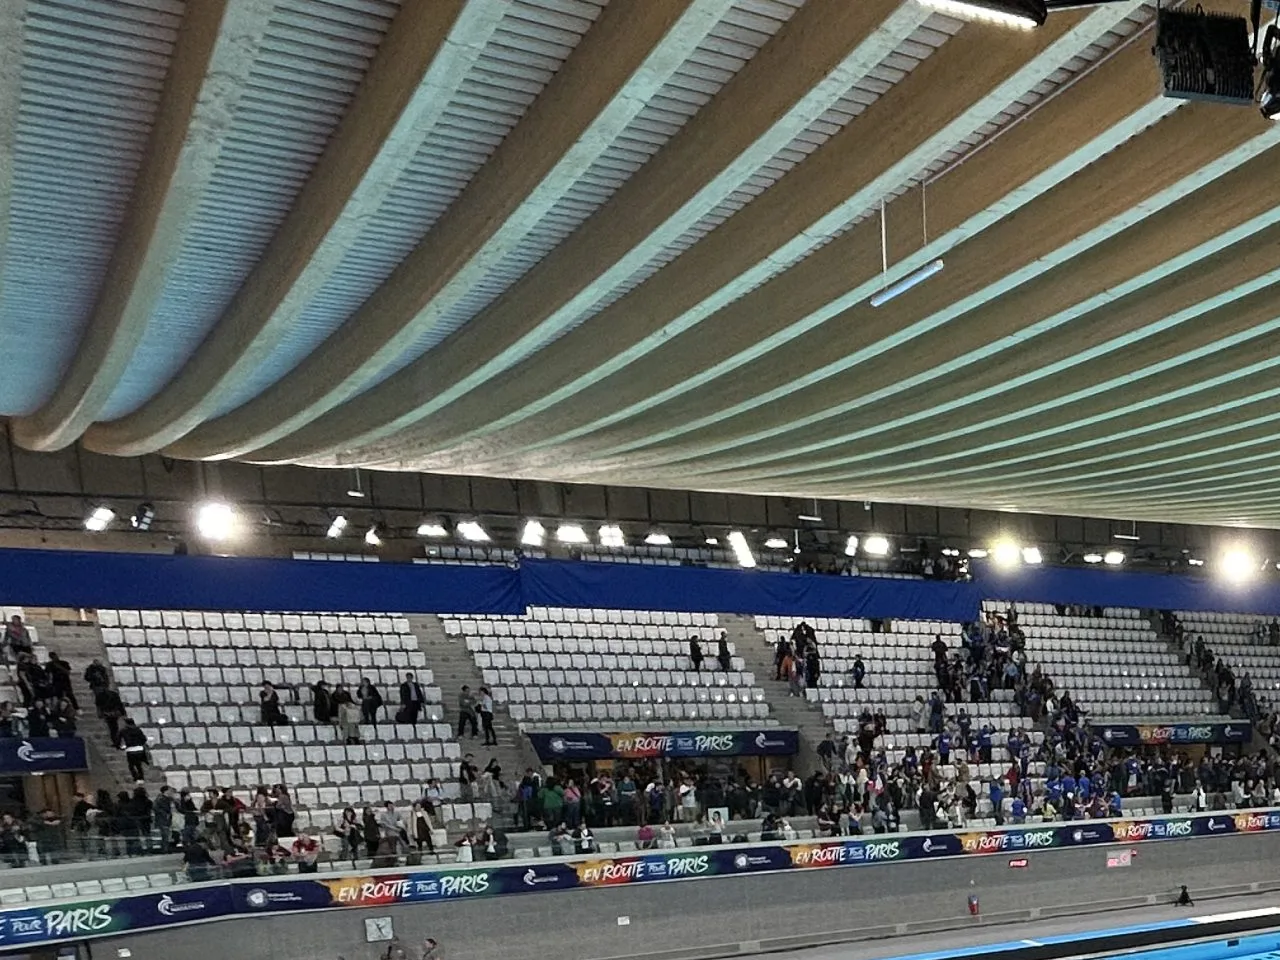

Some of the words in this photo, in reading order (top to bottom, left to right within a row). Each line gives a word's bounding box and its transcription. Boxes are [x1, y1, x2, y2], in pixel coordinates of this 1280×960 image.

[616, 740, 633, 752] EN
[634, 735, 674, 751] ROUTE
[695, 734, 734, 751] PARIS
[1024, 831, 1054, 848] PARIS
[795, 852, 811, 864] EN
[811, 847, 847, 863] ROUTE
[865, 841, 899, 860] PARIS
[583, 867, 601, 881] EN
[602, 861, 646, 881] ROUTE
[667, 855, 709, 875] PARIS
[338, 886, 360, 901] EN
[361, 878, 413, 901] ROUTE
[440, 873, 489, 895] PARIS
[43, 904, 112, 936] PARIS
